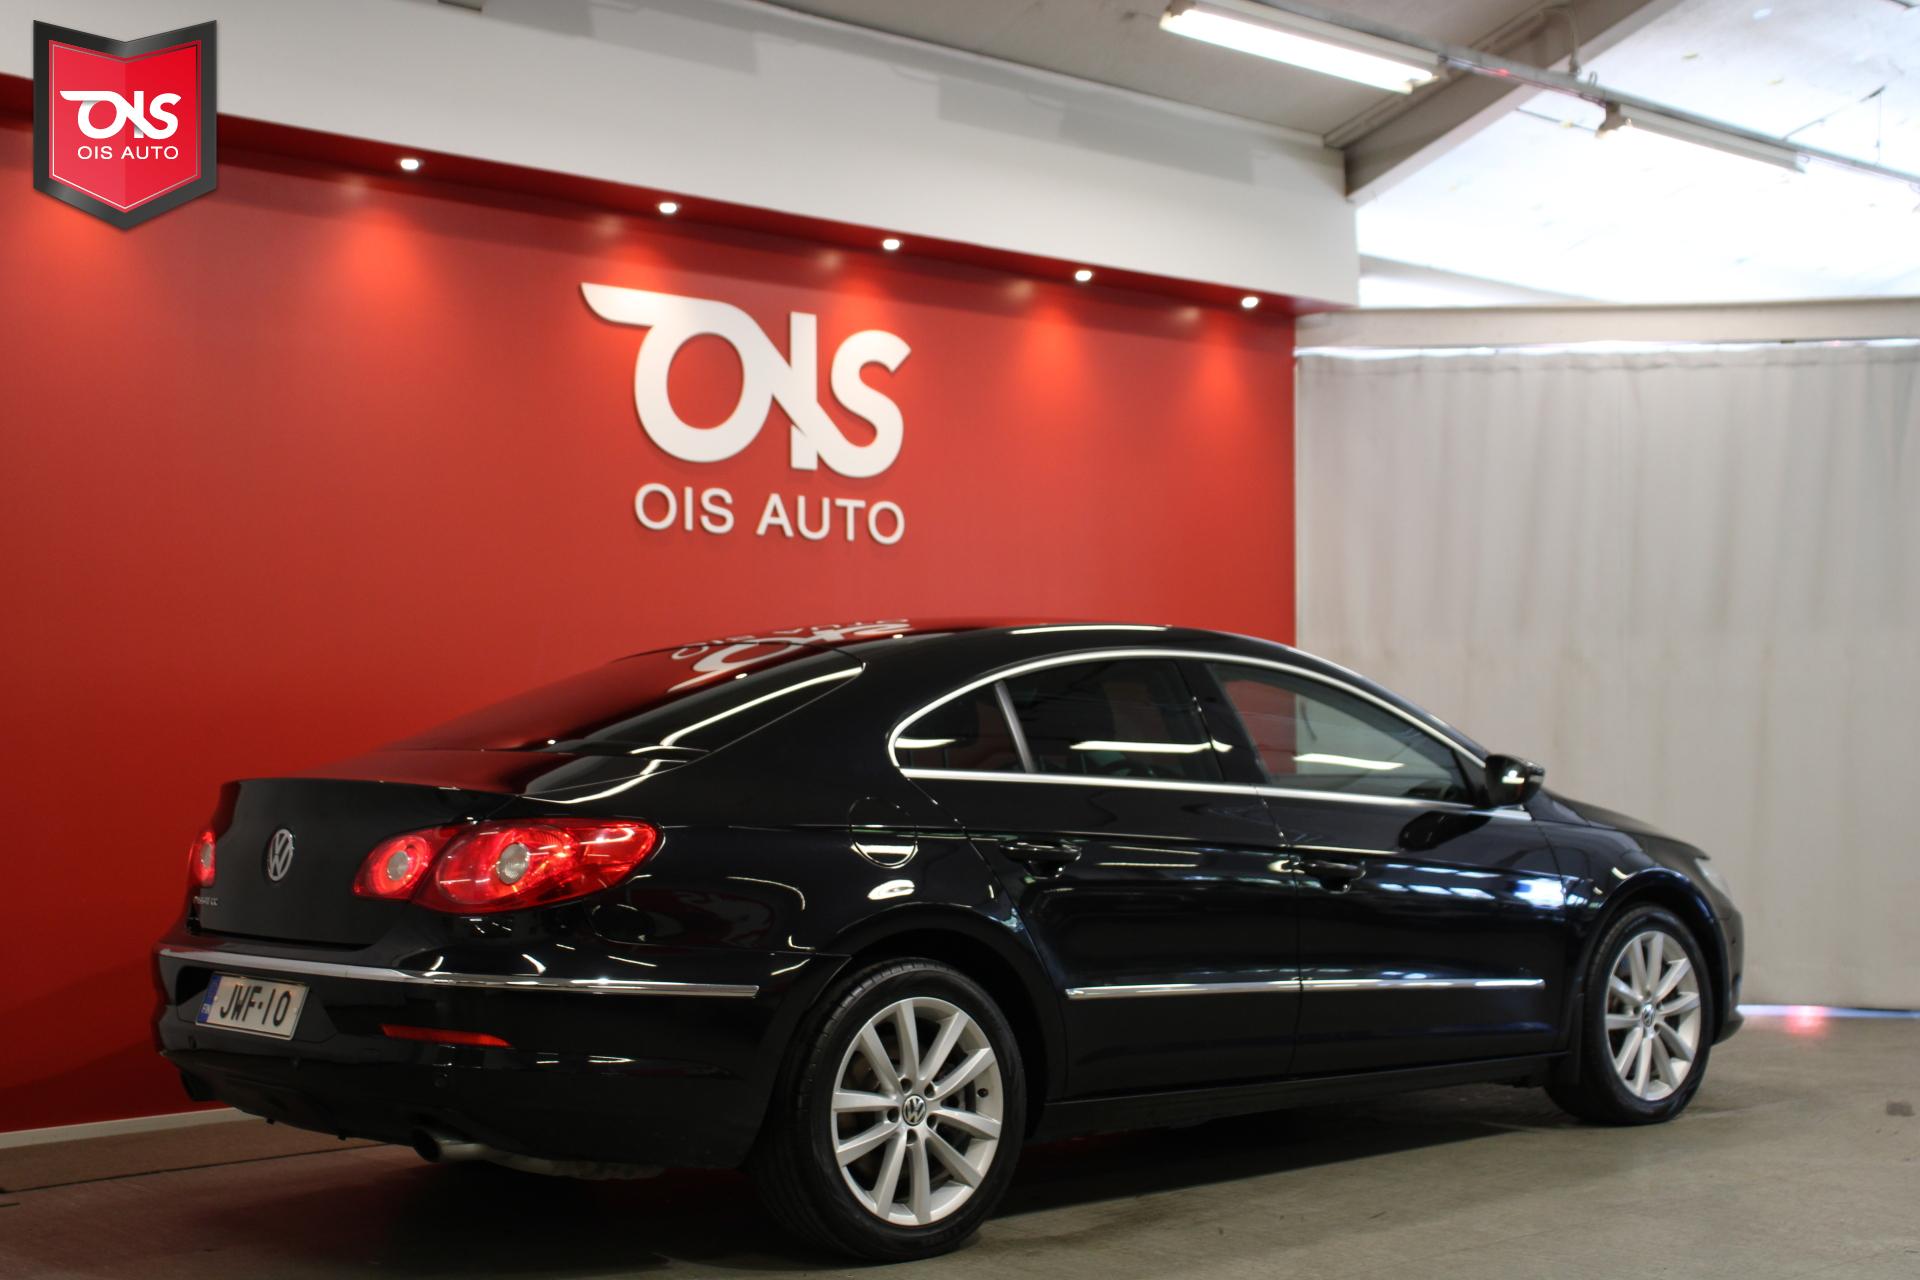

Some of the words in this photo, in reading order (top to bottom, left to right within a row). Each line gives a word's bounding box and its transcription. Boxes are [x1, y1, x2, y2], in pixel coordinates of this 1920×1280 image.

[580, 281, 912, 479] OIS
[633, 482, 735, 535] OIS
[755, 492, 906, 546] AUTO
[219, 984, 292, 1028] JWF-10
